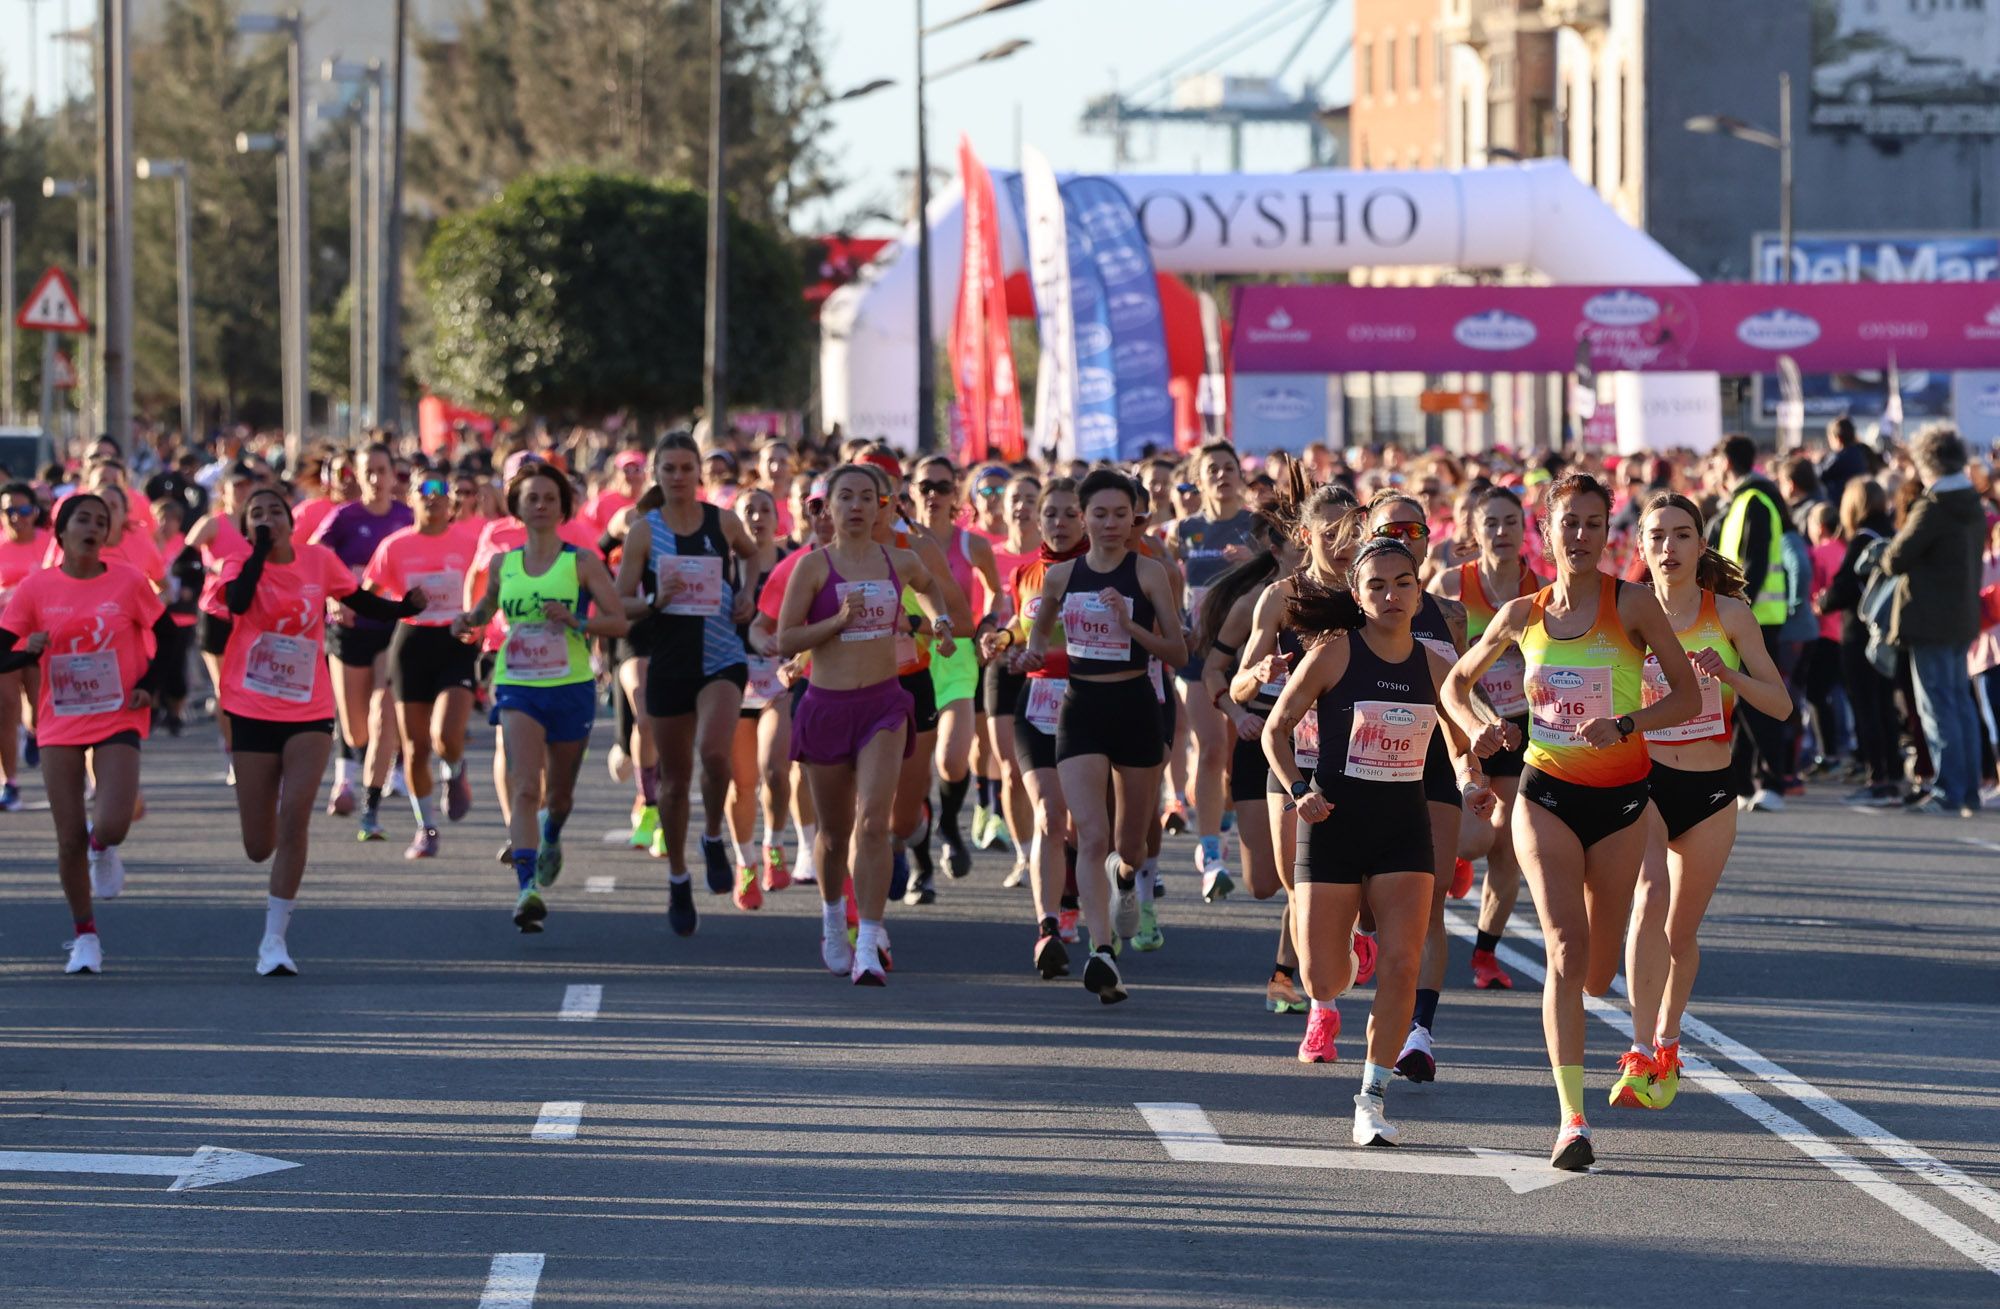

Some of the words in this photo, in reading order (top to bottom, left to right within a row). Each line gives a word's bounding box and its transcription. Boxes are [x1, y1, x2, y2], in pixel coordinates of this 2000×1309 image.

[1136, 187, 1419, 250] OYSHO
[1762, 243, 1861, 283] Del
[860, 606, 885, 618] 016
[1083, 622, 1109, 634] 016
[271, 662, 296, 675] 016
[74, 680, 99, 691] 016
[1377, 680, 1410, 692] OYSHO
[1487, 680, 1512, 693] 016
[1551, 676, 1582, 685] ASTURIANA
[1554, 702, 1585, 715] 016
[1385, 712, 1414, 722] ASTURIANA
[1688, 726, 1714, 735] Santander
[1381, 738, 1410, 751] 016
[1356, 766, 1383, 776] OYSHO
